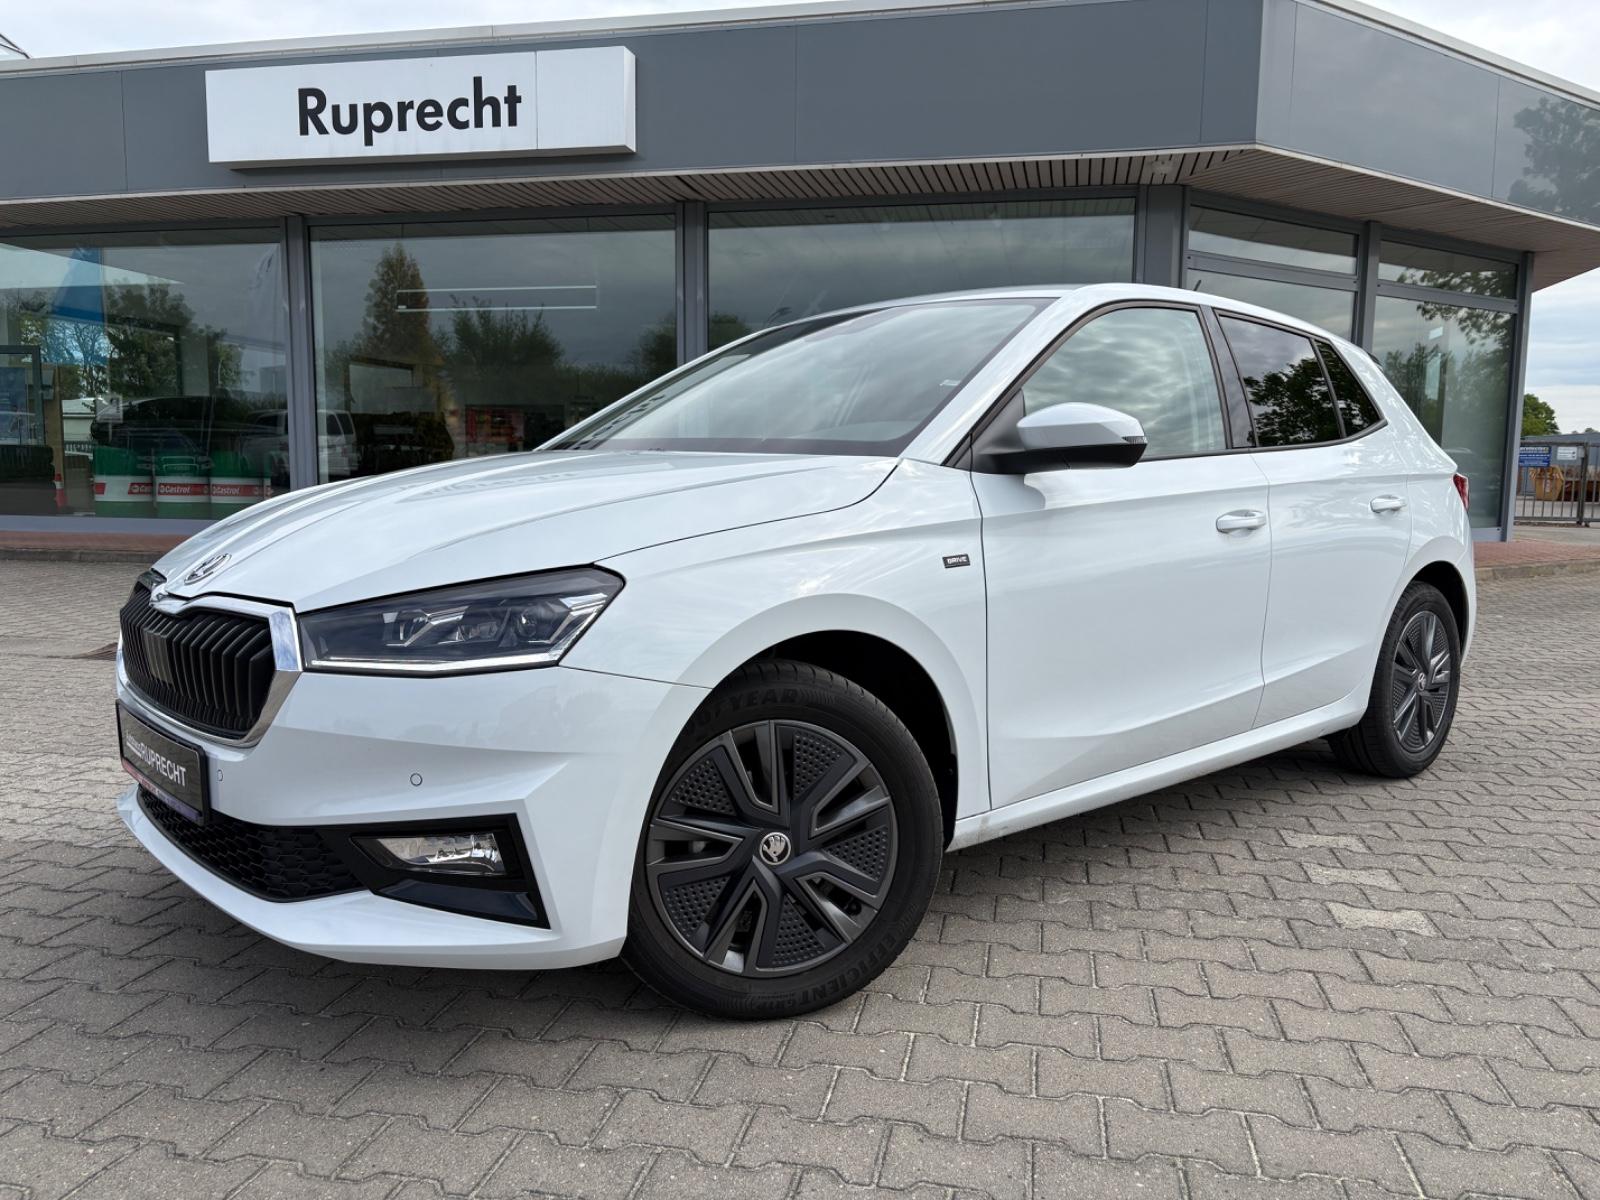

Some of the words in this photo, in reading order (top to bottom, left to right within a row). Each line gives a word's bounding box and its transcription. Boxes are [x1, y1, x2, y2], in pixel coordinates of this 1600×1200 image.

[297, 75, 523, 147] Ruprecht
[165, 485, 191, 494] Castrol
[217, 486, 240, 495] Castrol
[946, 556, 967, 564] DRIVE
[140, 743, 187, 786] RUPRECHT
[799, 933, 897, 1004] EFFICIENT
